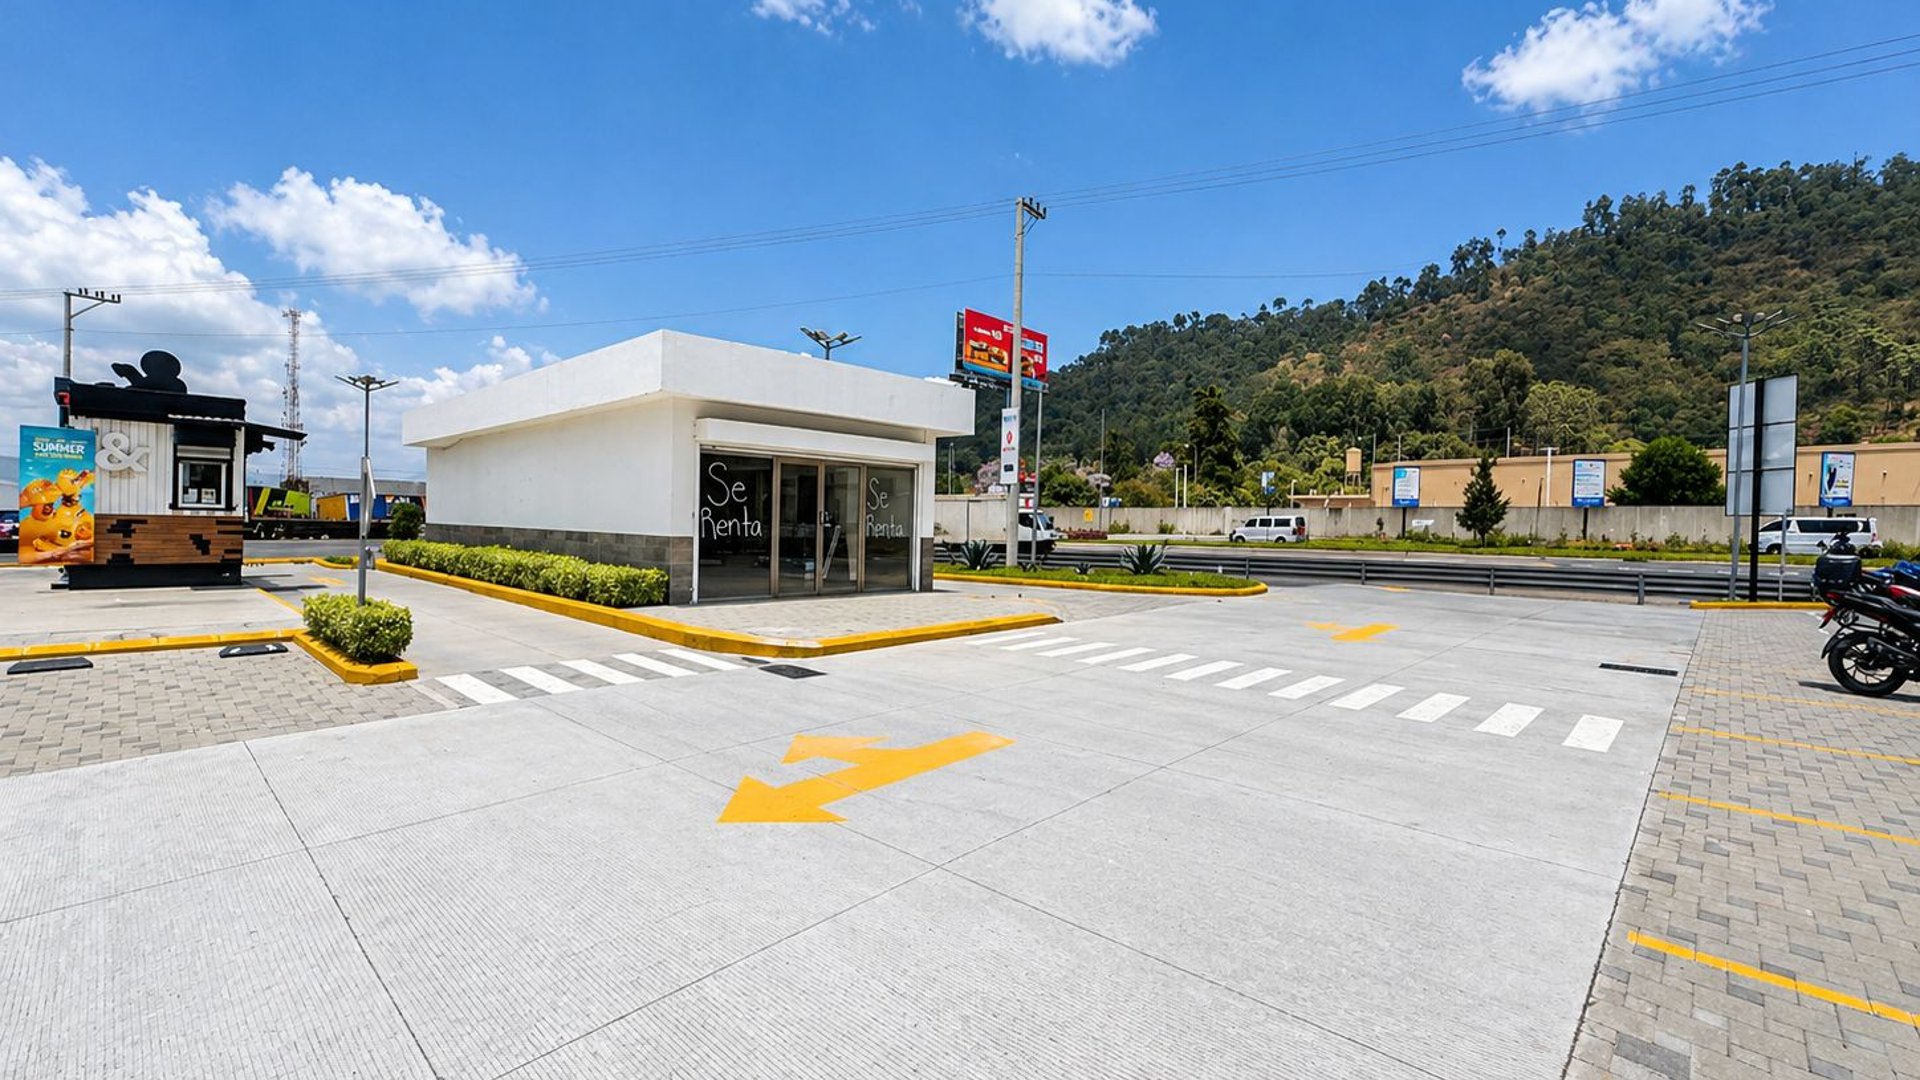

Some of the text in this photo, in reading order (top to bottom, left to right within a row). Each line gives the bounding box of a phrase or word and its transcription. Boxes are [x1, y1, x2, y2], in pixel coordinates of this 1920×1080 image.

[33, 441, 85, 455] SUMMER
[95, 432, 150, 472] &
[707, 461, 748, 507] Se
[866, 477, 889, 510] Se
[701, 505, 762, 540] Renta
[866, 513, 906, 540] Renta
